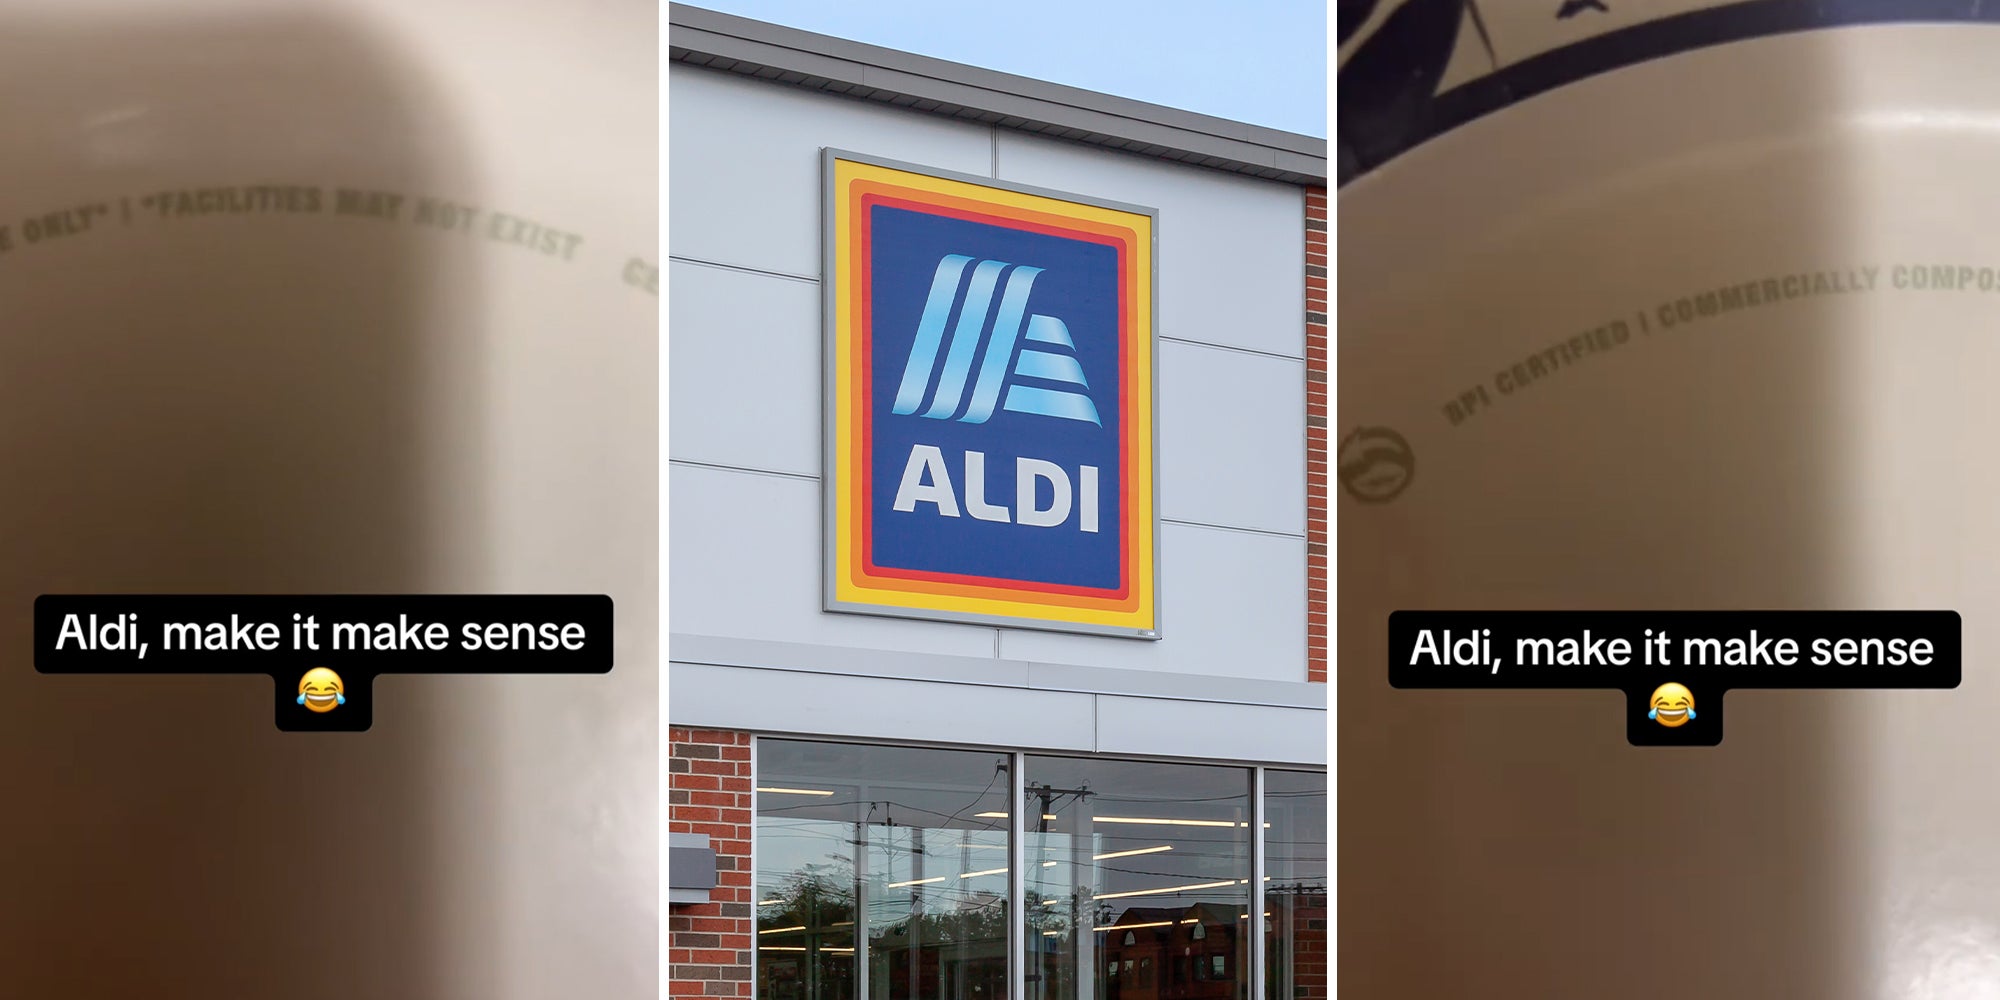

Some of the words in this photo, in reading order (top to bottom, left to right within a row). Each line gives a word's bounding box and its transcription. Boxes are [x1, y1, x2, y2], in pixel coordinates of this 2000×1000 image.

[334, 189, 402, 220] MAY
[414, 199, 479, 232] NOT
[490, 212, 583, 261] EXIST
[1442, 385, 1491, 426] BPI
[1495, 320, 1629, 395] CERTIFIED
[1657, 267, 1879, 329] COMMERCIALLY
[893, 444, 1099, 533] ALDI
